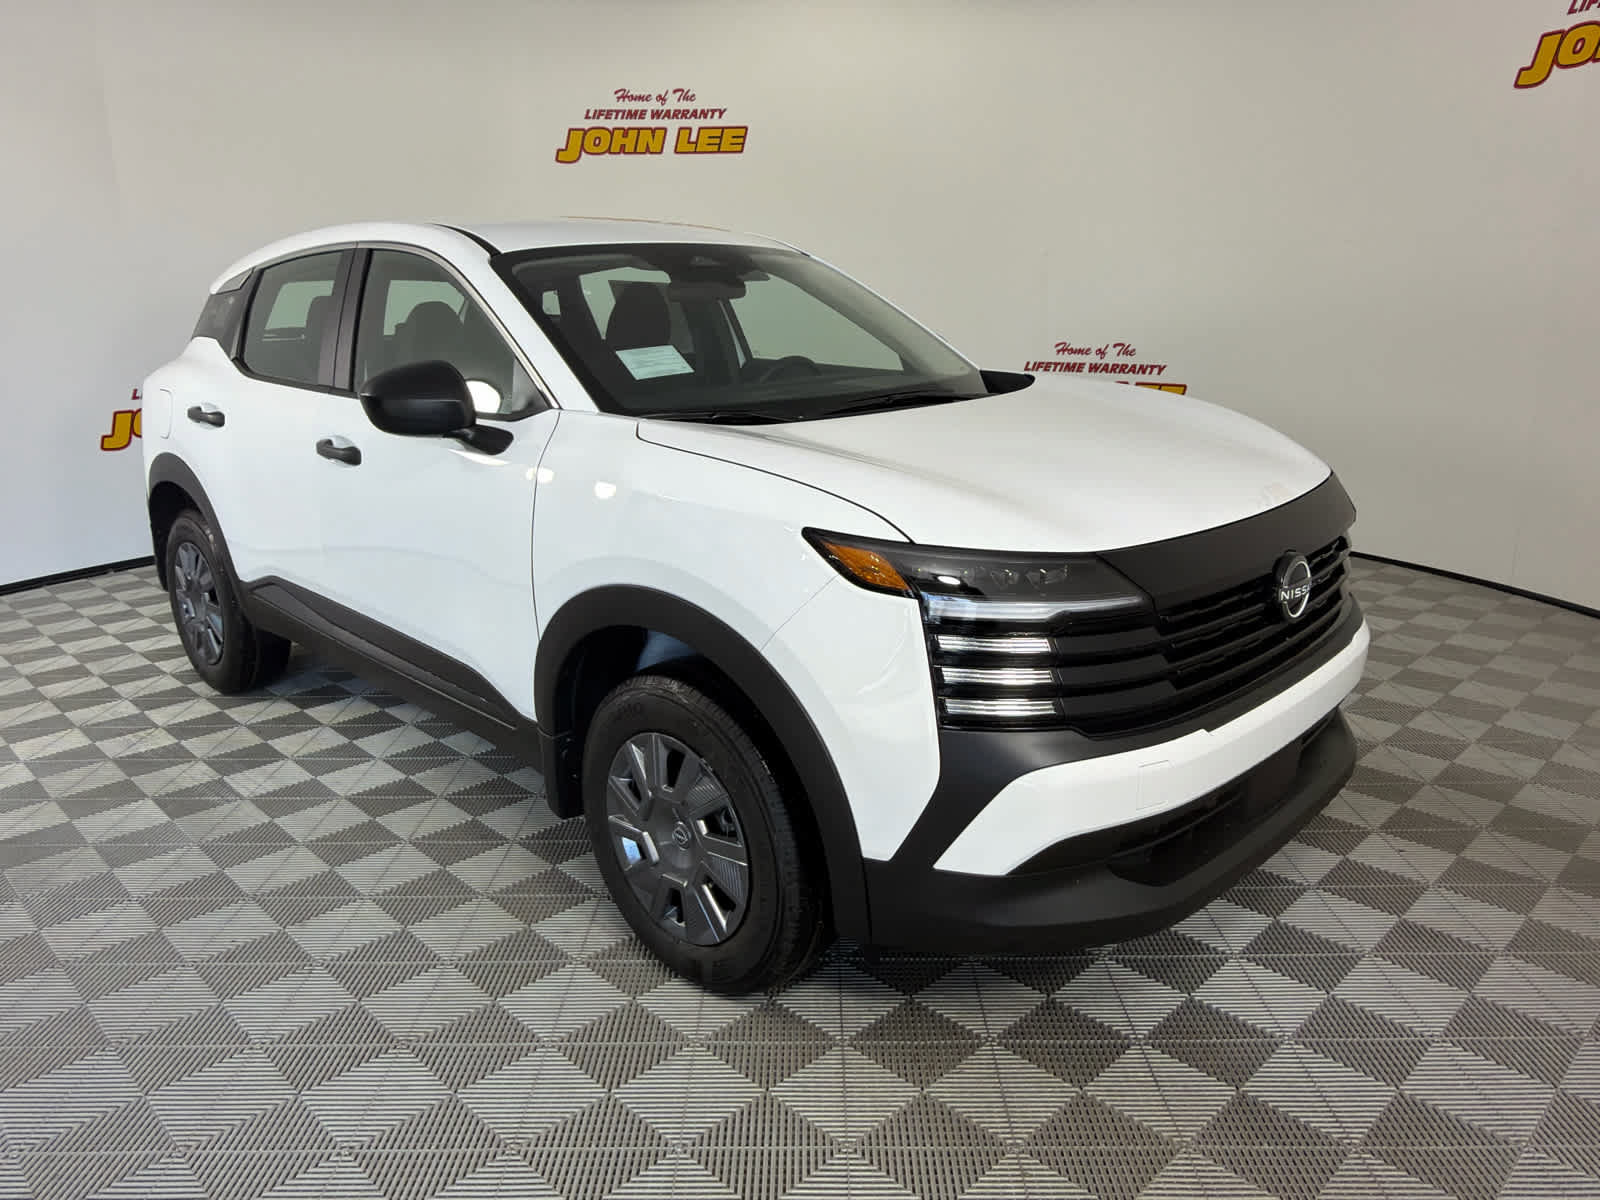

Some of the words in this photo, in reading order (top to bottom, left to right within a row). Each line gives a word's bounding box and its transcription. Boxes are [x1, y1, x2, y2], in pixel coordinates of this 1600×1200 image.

[1513, 20, 1600, 89] JO
[614, 88, 652, 103] Home
[655, 89, 669, 106] of
[672, 88, 696, 103] The
[584, 109, 647, 120] LIFETIME
[650, 108, 727, 120] WARRANTY
[555, 126, 667, 164] JOHN
[674, 126, 748, 154] LEE
[1054, 341, 1092, 356] Home
[1095, 344, 1109, 360] of
[1112, 343, 1137, 357] The
[1024, 361, 1086, 373] LIFETIME
[1088, 362, 1167, 376] WARRANTY
